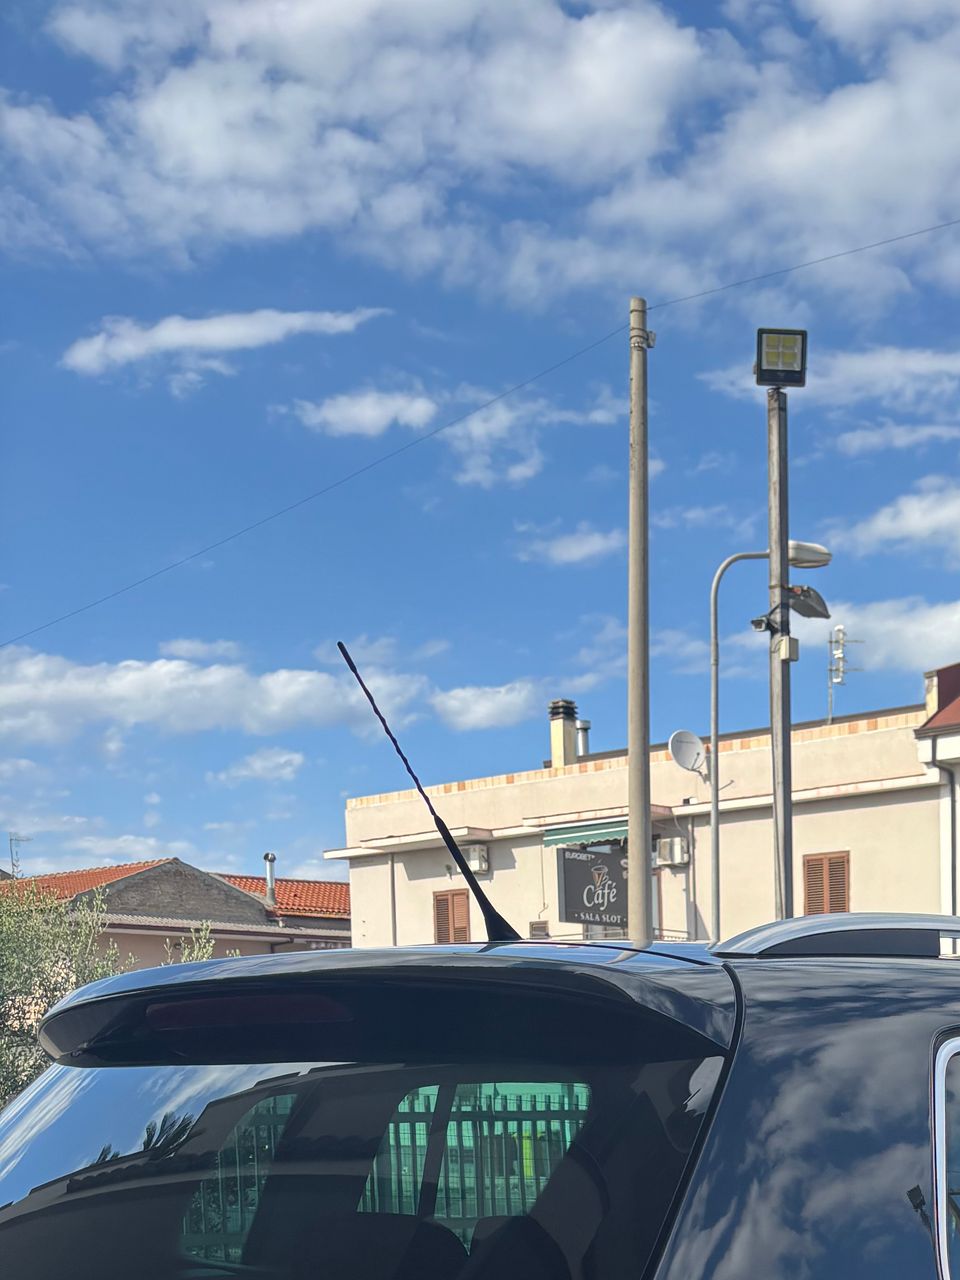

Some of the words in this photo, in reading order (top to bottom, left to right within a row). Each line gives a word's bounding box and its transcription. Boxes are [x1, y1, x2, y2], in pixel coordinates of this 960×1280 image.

[583, 881, 617, 910] Café
[580, 912, 600, 922] SALA
[602, 914, 621, 923] SLOT
